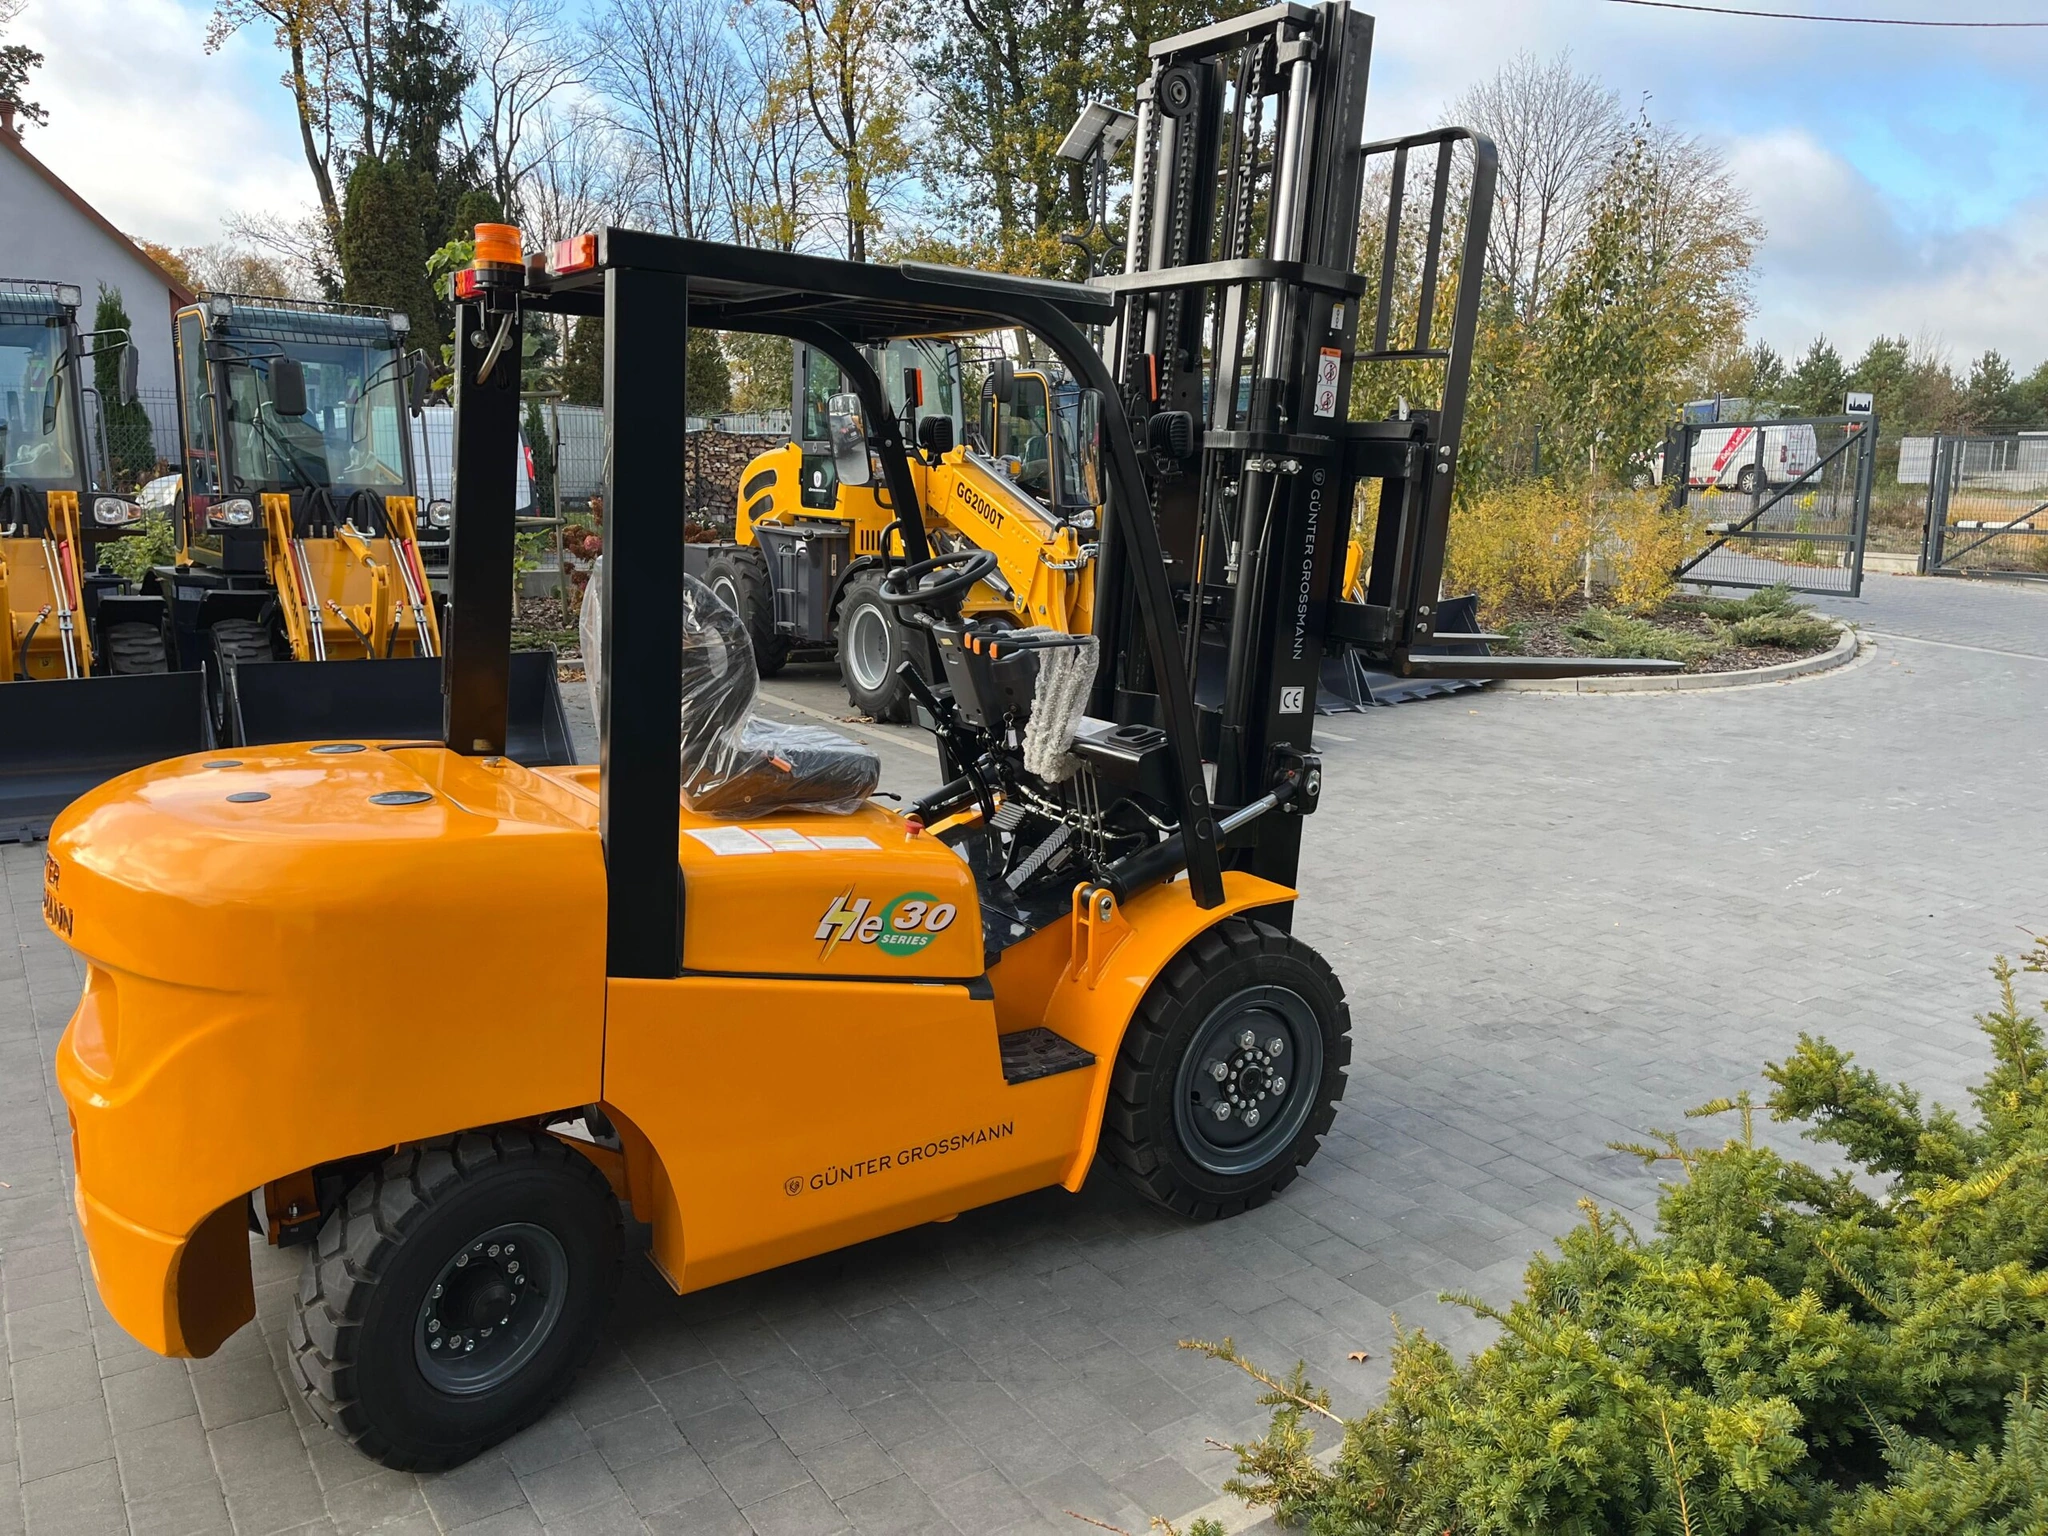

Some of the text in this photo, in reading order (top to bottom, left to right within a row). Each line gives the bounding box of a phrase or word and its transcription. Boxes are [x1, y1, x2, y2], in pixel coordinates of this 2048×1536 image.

[957, 481, 1005, 530] GG2000T
[1292, 489, 1321, 660] GÜNTER GROSSMANN
[881, 934, 929, 946] SERIES
[893, 900, 958, 932] 30
[809, 1121, 1014, 1190] GÜNTER GROSSMANN
